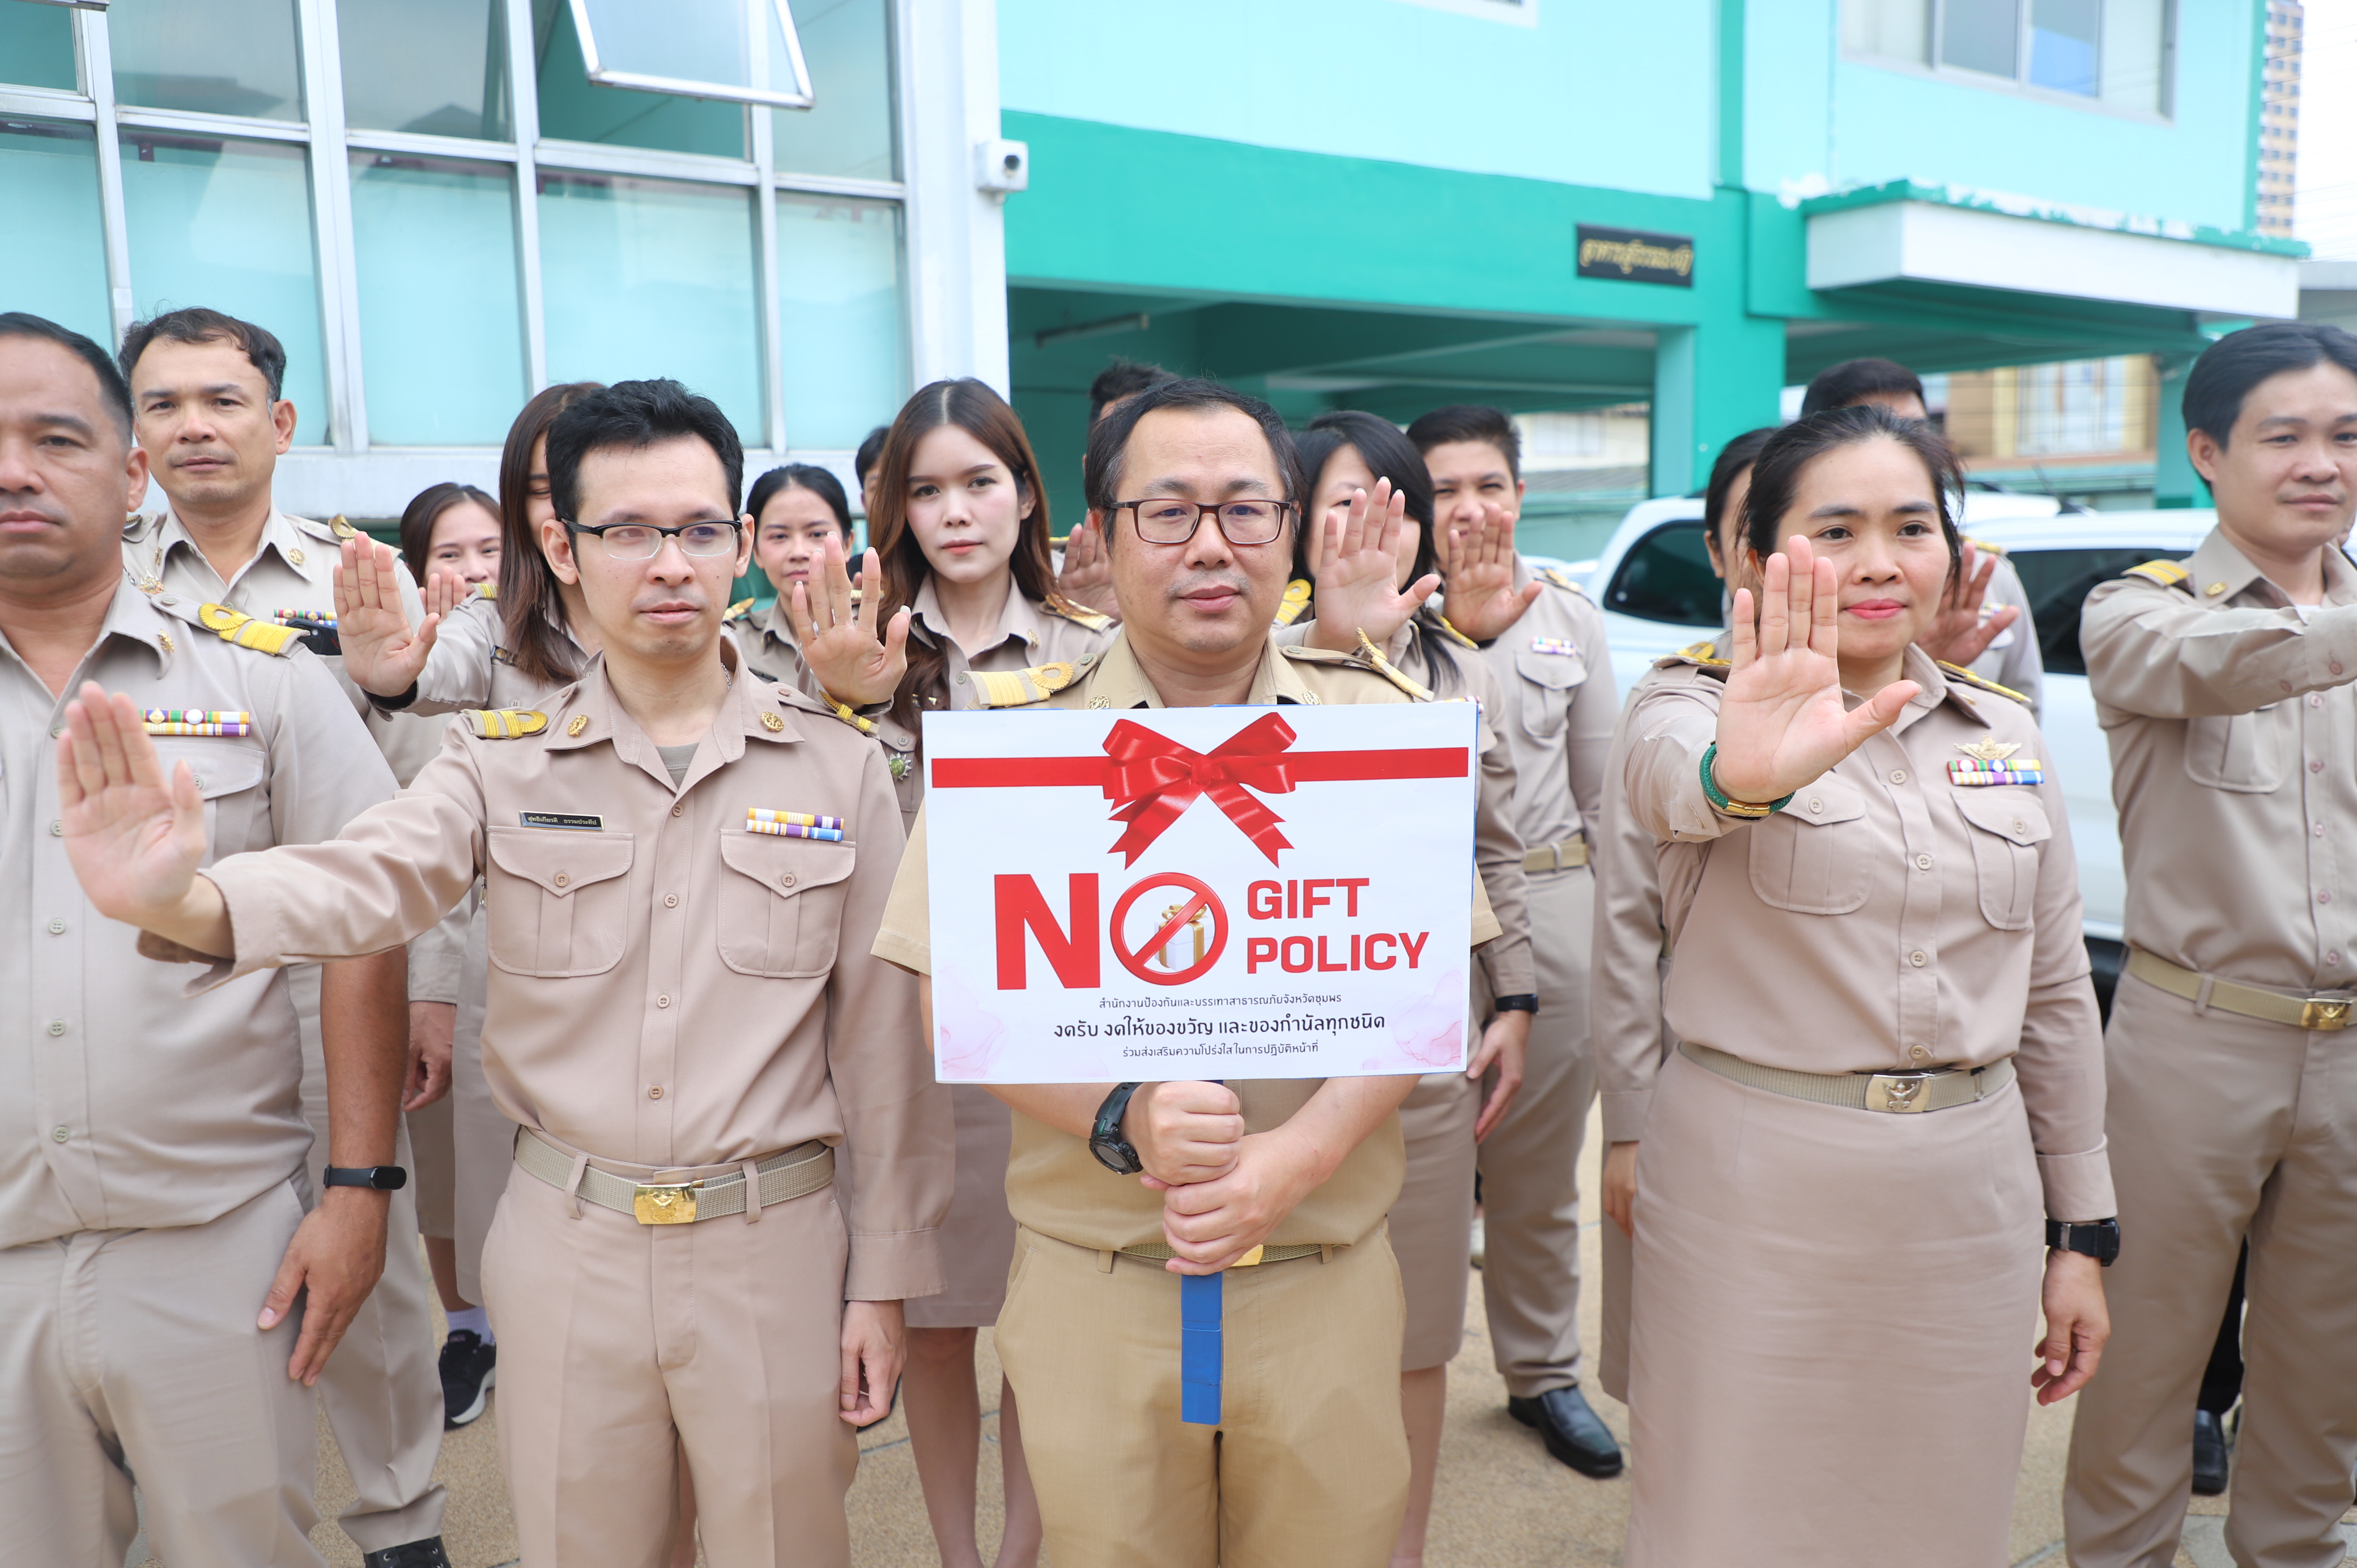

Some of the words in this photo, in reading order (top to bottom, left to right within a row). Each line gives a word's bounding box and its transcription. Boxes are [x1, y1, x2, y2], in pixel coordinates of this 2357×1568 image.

[1248, 877, 1369, 920] GIFT
[1248, 932, 1429, 974] POLICY
[1099, 993, 1342, 1008] สำนักงานป้องกันและบรรเทาสาธารณภัยจังหวัดชุมพร
[1054, 1019, 1098, 1037] งดรับ
[1104, 1015, 1213, 1037] งดให้ของขวัญ
[1219, 1013, 1385, 1036] และของกำนัลทุกชนิด
